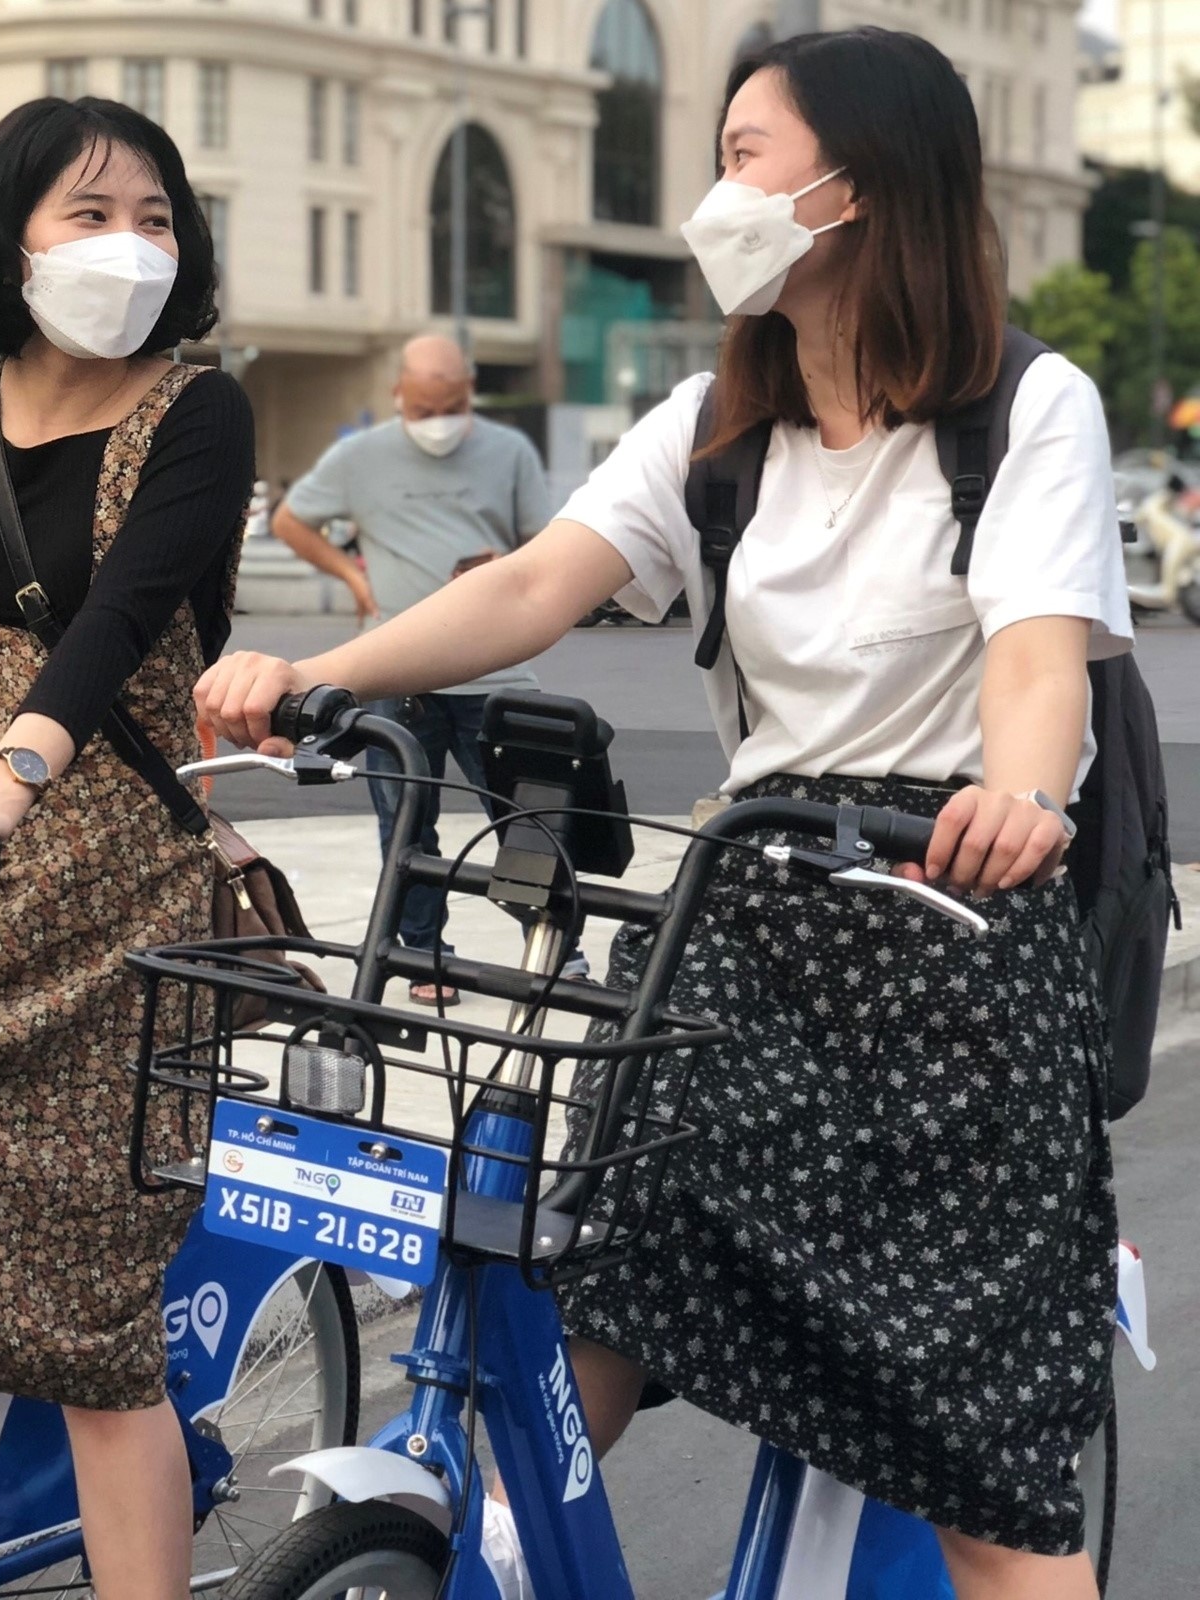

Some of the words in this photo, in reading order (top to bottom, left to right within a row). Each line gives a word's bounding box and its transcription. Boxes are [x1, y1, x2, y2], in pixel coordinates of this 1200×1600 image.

[228, 1129, 240, 1138] TP.
[272, 1139, 296, 1152] MINH
[347, 1156, 364, 1168] TẬP
[365, 1161, 391, 1174] ĐOÀN
[392, 1167, 407, 1178] TRÍ
[407, 1171, 429, 1184] NAM
[219, 1187, 292, 1232] X51B
[315, 1212, 423, 1265] 21.628
[394, 1192, 422, 1211] TN
[162, 1281, 229, 1360] GO
[549, 1343, 593, 1503] TNGO
